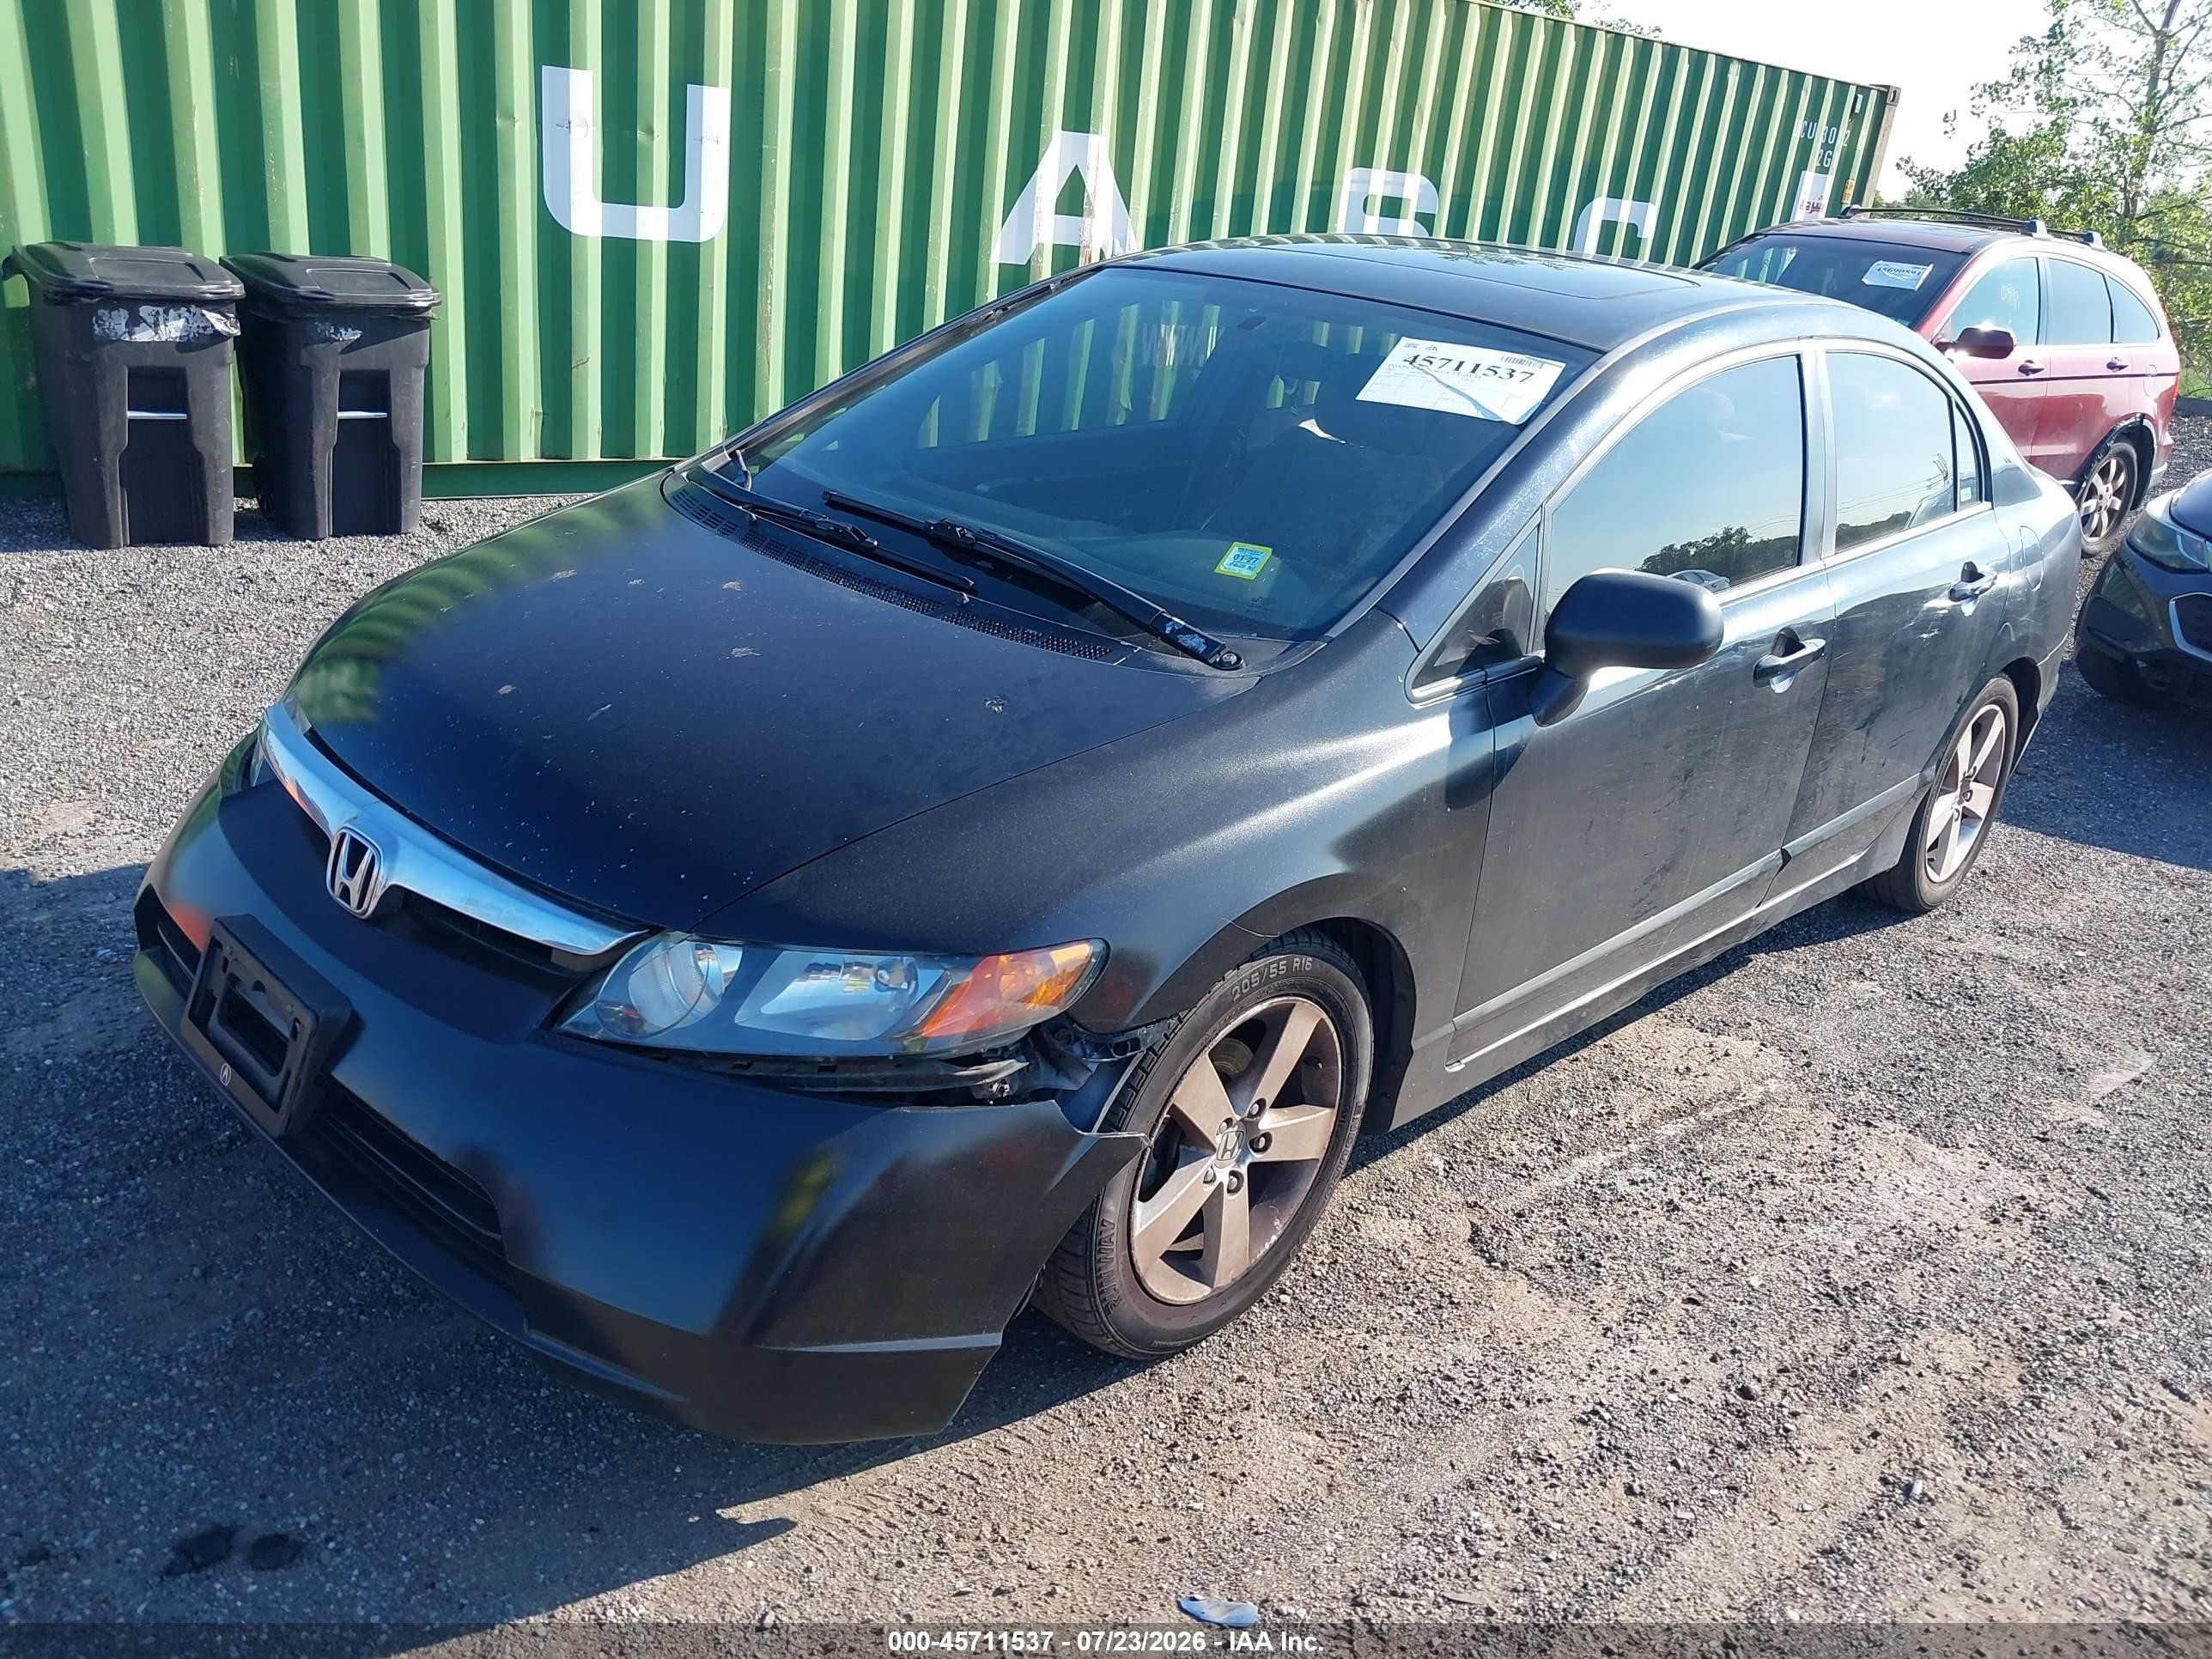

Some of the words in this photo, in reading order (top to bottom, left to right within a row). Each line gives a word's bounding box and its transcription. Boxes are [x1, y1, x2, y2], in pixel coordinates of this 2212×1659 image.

[1402, 353, 1534, 384] 45711537
[1231, 960, 1287, 1002] 205/55
[1292, 957, 1313, 972] R16
